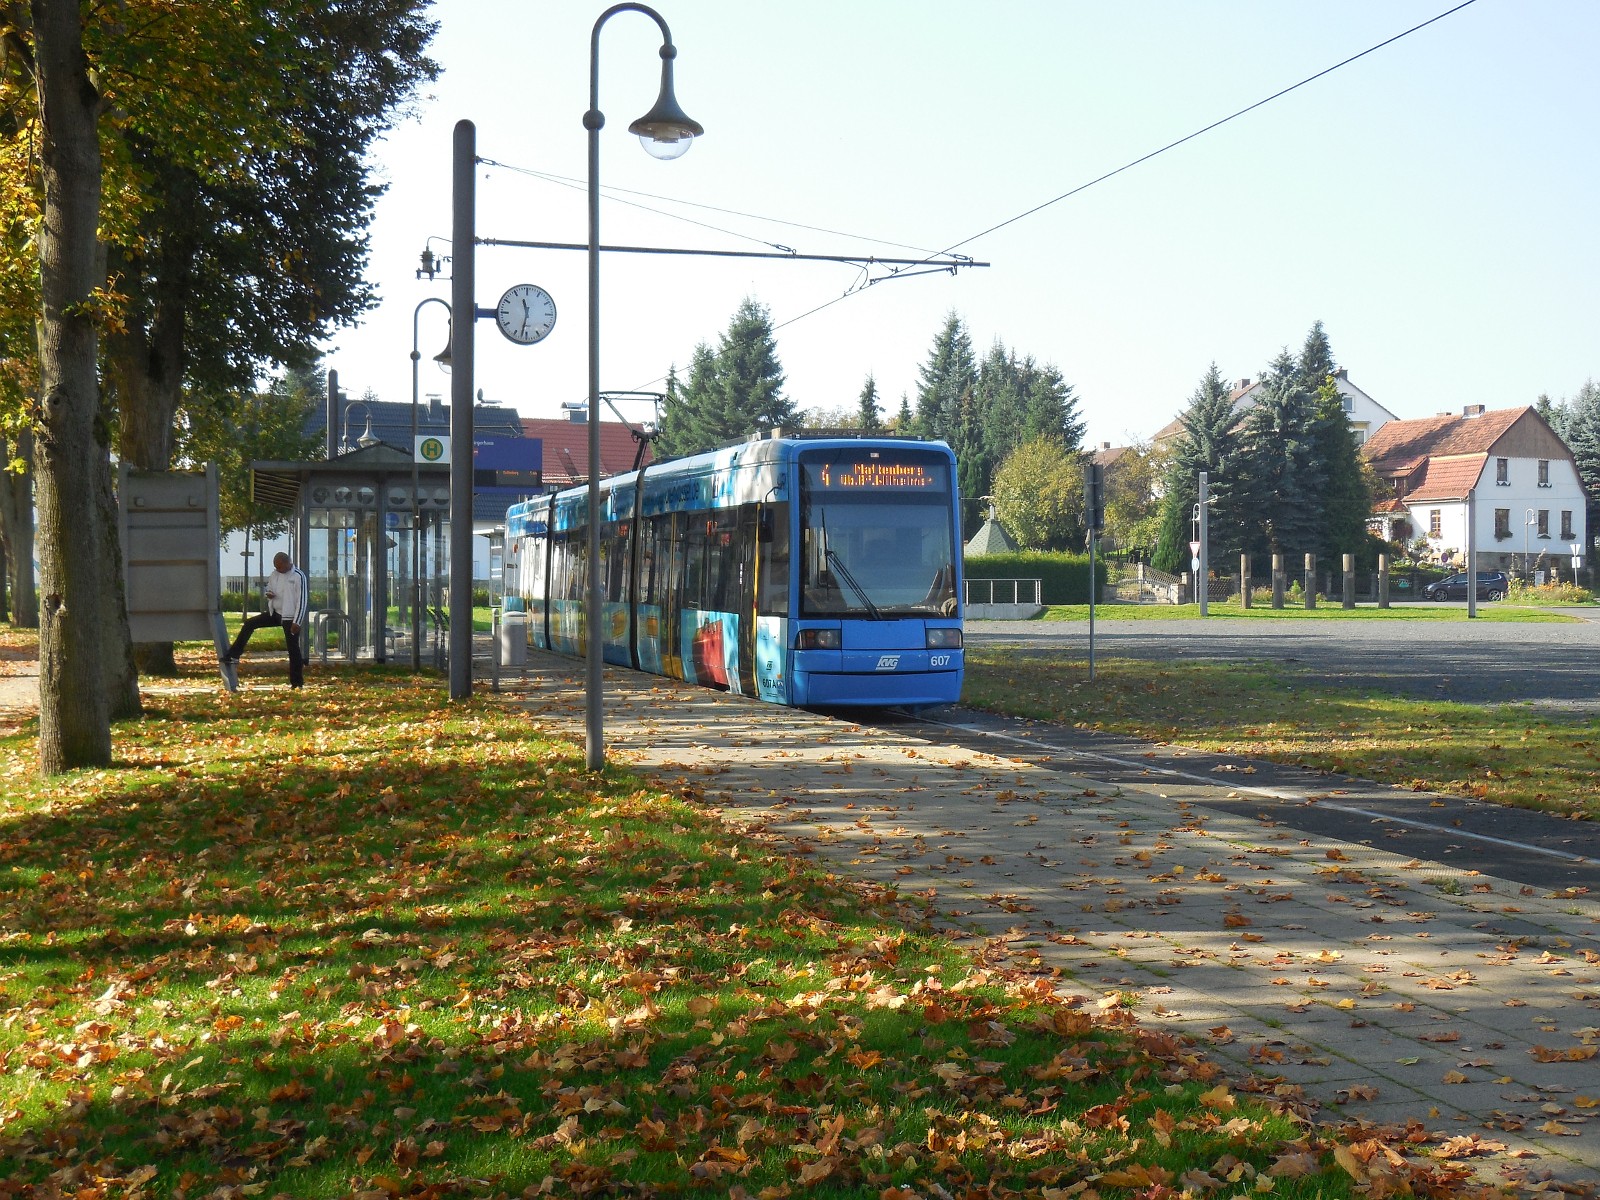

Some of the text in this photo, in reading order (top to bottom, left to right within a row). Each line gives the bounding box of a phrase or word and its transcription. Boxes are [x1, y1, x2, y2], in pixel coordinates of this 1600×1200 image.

[426, 443, 438, 456] H
[821, 463, 831, 486] 4
[854, 463, 923, 476] Mattenberg
[876, 656, 900, 669] KVG
[930, 655, 951, 667] 607
